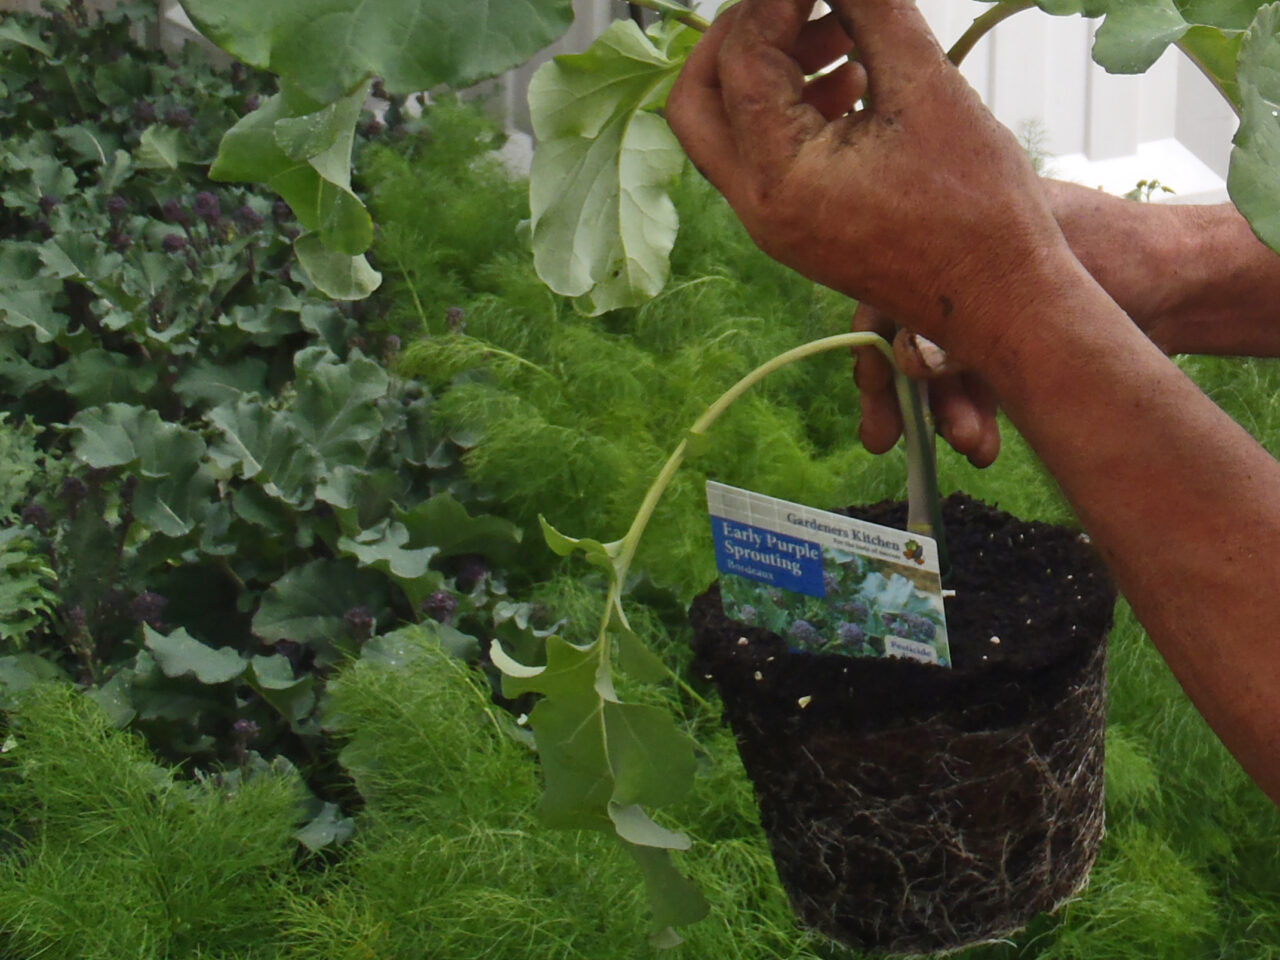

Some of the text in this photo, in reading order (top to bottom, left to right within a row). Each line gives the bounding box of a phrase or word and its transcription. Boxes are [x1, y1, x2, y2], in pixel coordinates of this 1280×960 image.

[723, 522, 819, 560] Early Purple
[787, 512, 900, 552] Gardeners Kitchen
[725, 540, 802, 576] Sprouting
